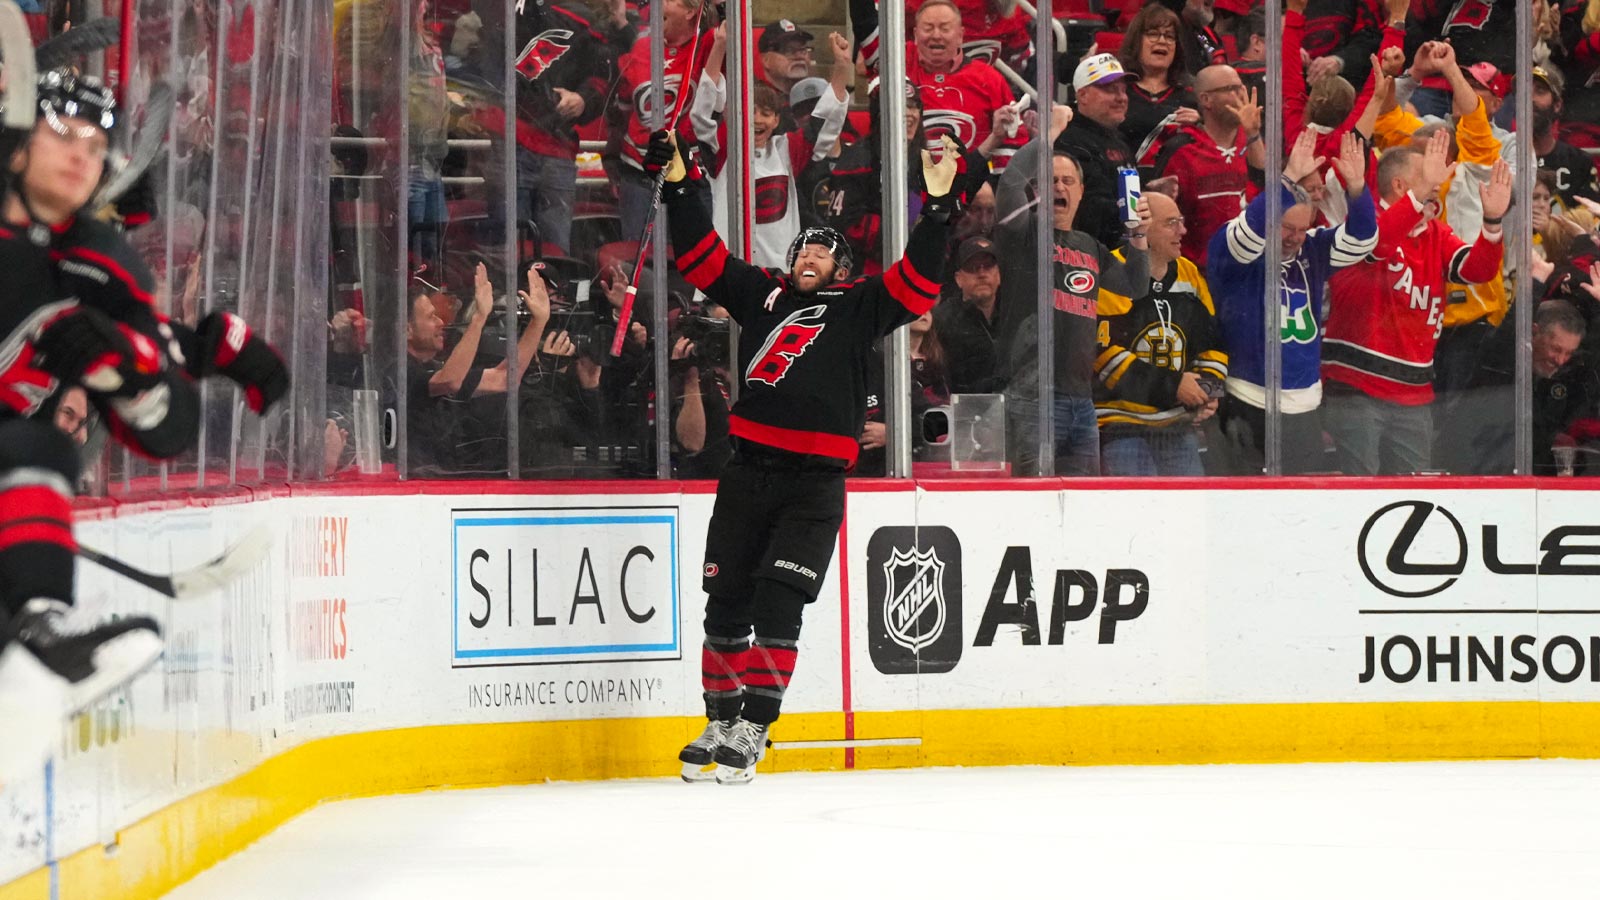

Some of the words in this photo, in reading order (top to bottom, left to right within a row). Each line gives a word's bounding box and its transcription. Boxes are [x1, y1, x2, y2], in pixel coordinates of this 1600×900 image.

[1556, 167, 1571, 190] C
[763, 286, 782, 311] A
[469, 545, 656, 629] SILAC
[896, 573, 934, 630] NHL
[468, 681, 556, 708] INSURANCE
